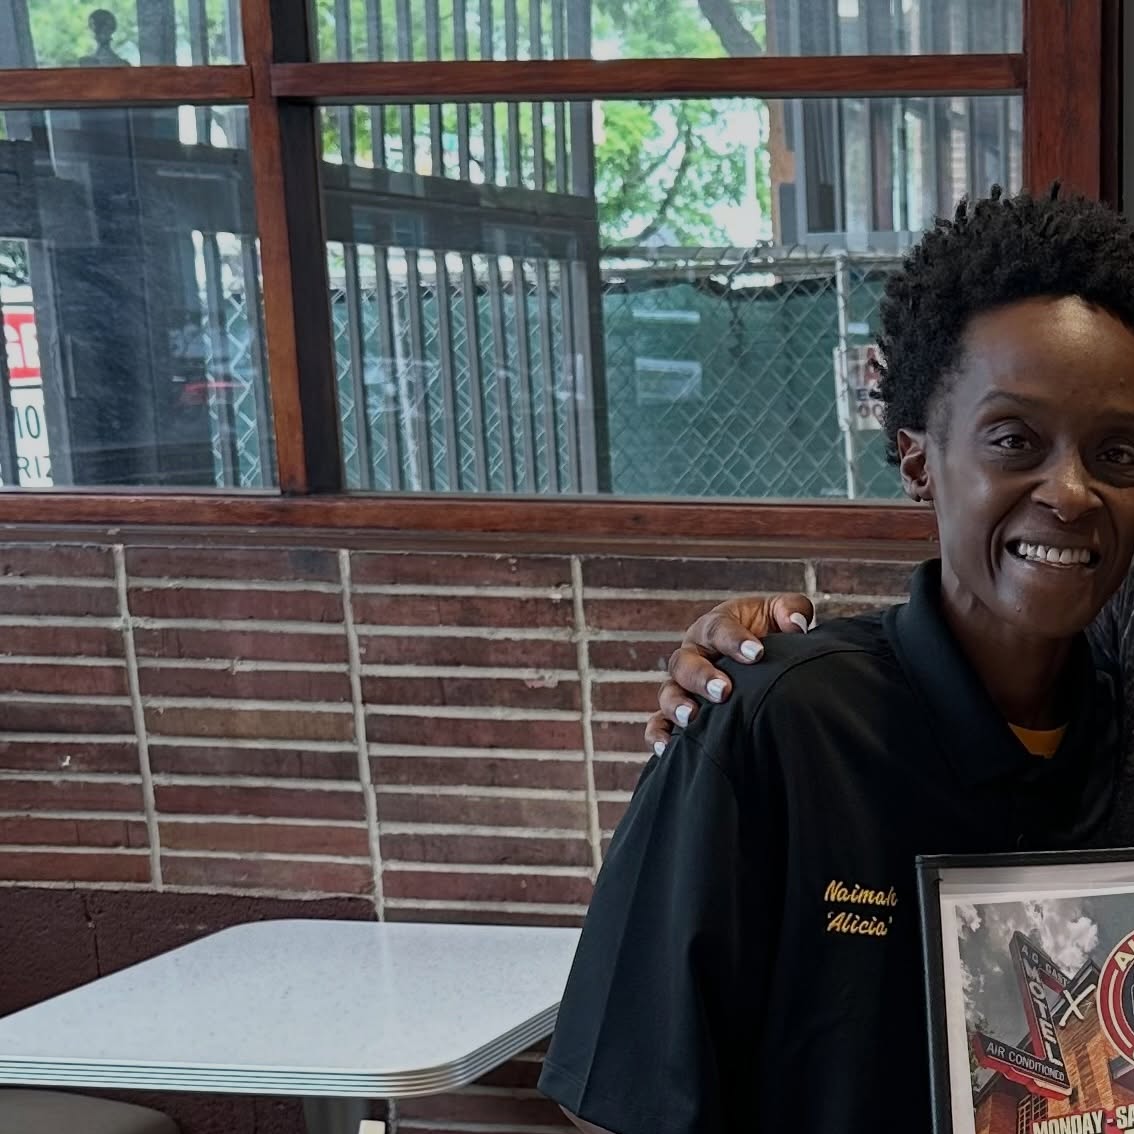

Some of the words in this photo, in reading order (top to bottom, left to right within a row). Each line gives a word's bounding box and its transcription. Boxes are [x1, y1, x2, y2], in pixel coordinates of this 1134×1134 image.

[824, 880, 898, 906] Naimah
[1023, 957, 1063, 1066] MOTEL
[986, 1042, 1005, 1058] AIR
